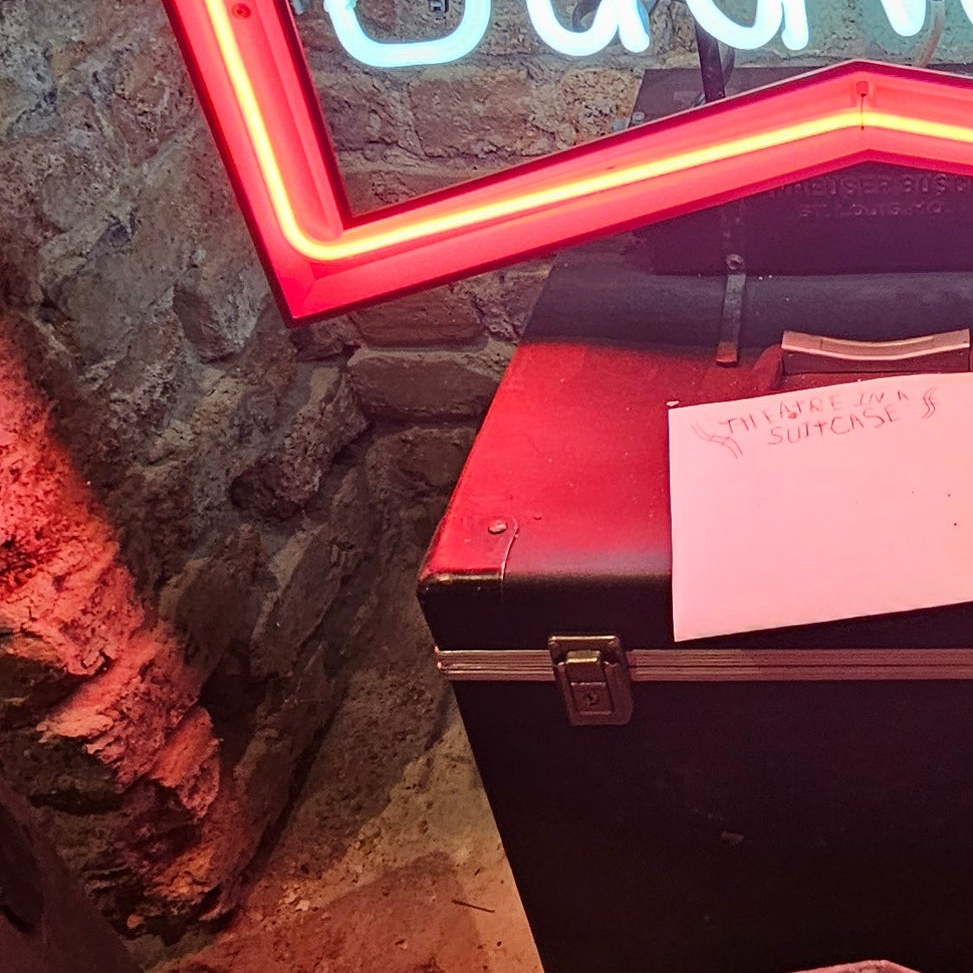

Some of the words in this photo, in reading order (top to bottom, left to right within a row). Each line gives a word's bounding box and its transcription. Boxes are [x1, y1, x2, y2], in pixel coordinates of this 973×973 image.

[718, 394, 841, 434] THEATRE
[853, 390, 885, 407] IN
[896, 389, 910, 403] A
[766, 404, 900, 446] SUITCASE
